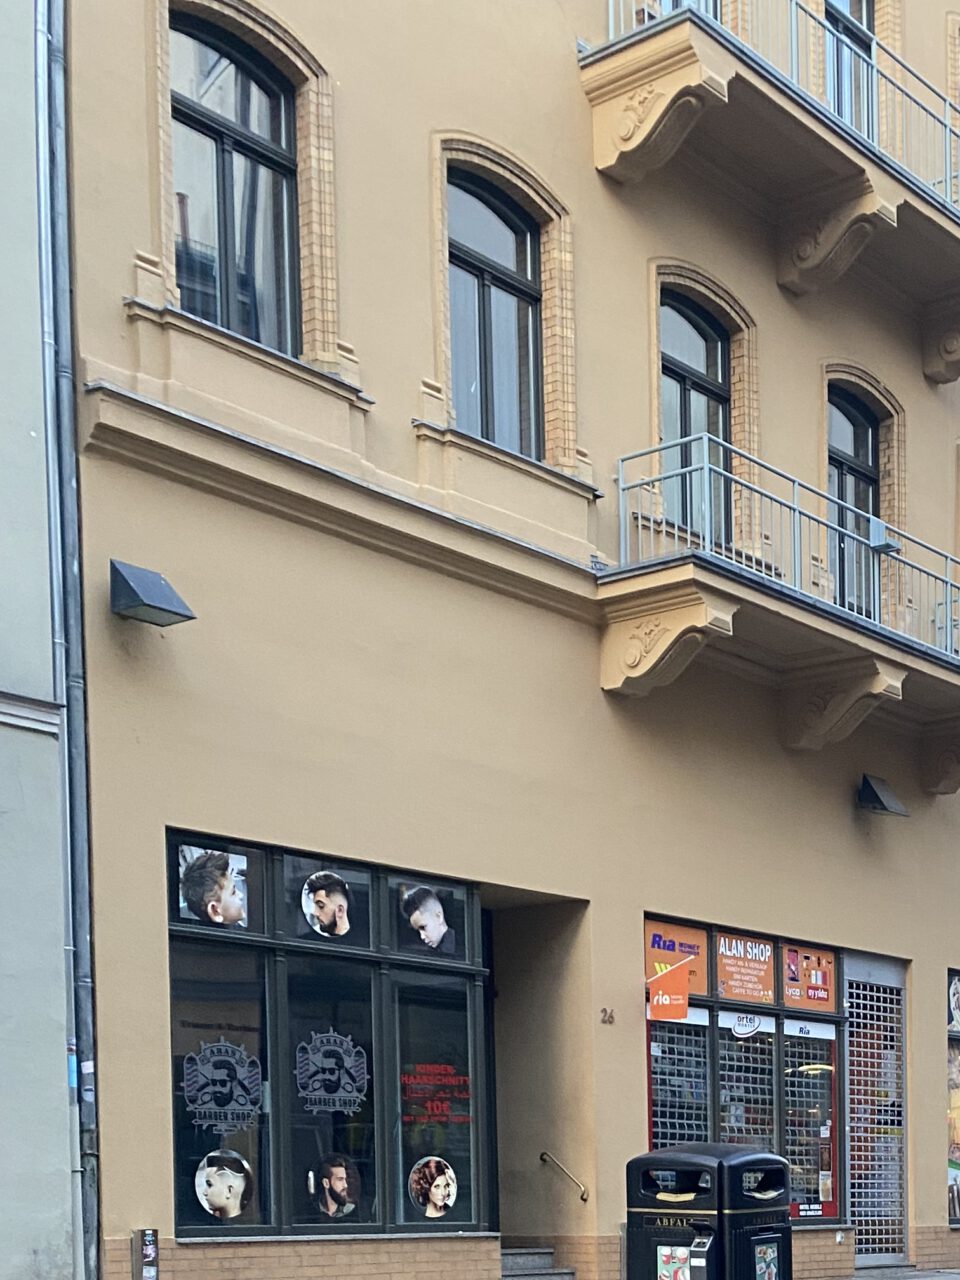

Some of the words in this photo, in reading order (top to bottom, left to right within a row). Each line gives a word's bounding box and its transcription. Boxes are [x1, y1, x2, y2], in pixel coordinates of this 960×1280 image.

[651, 933, 676, 952] Ria
[719, 937, 745, 958] ALAN
[746, 941, 771, 962] SHOP
[654, 990, 670, 1005] ria
[600, 1007, 615, 1025] 26
[737, 1015, 756, 1024] ortel
[799, 1024, 810, 1036] Ria
[425, 1100, 451, 1115] 10€
[230, 1111, 253, 1121] SHOP
